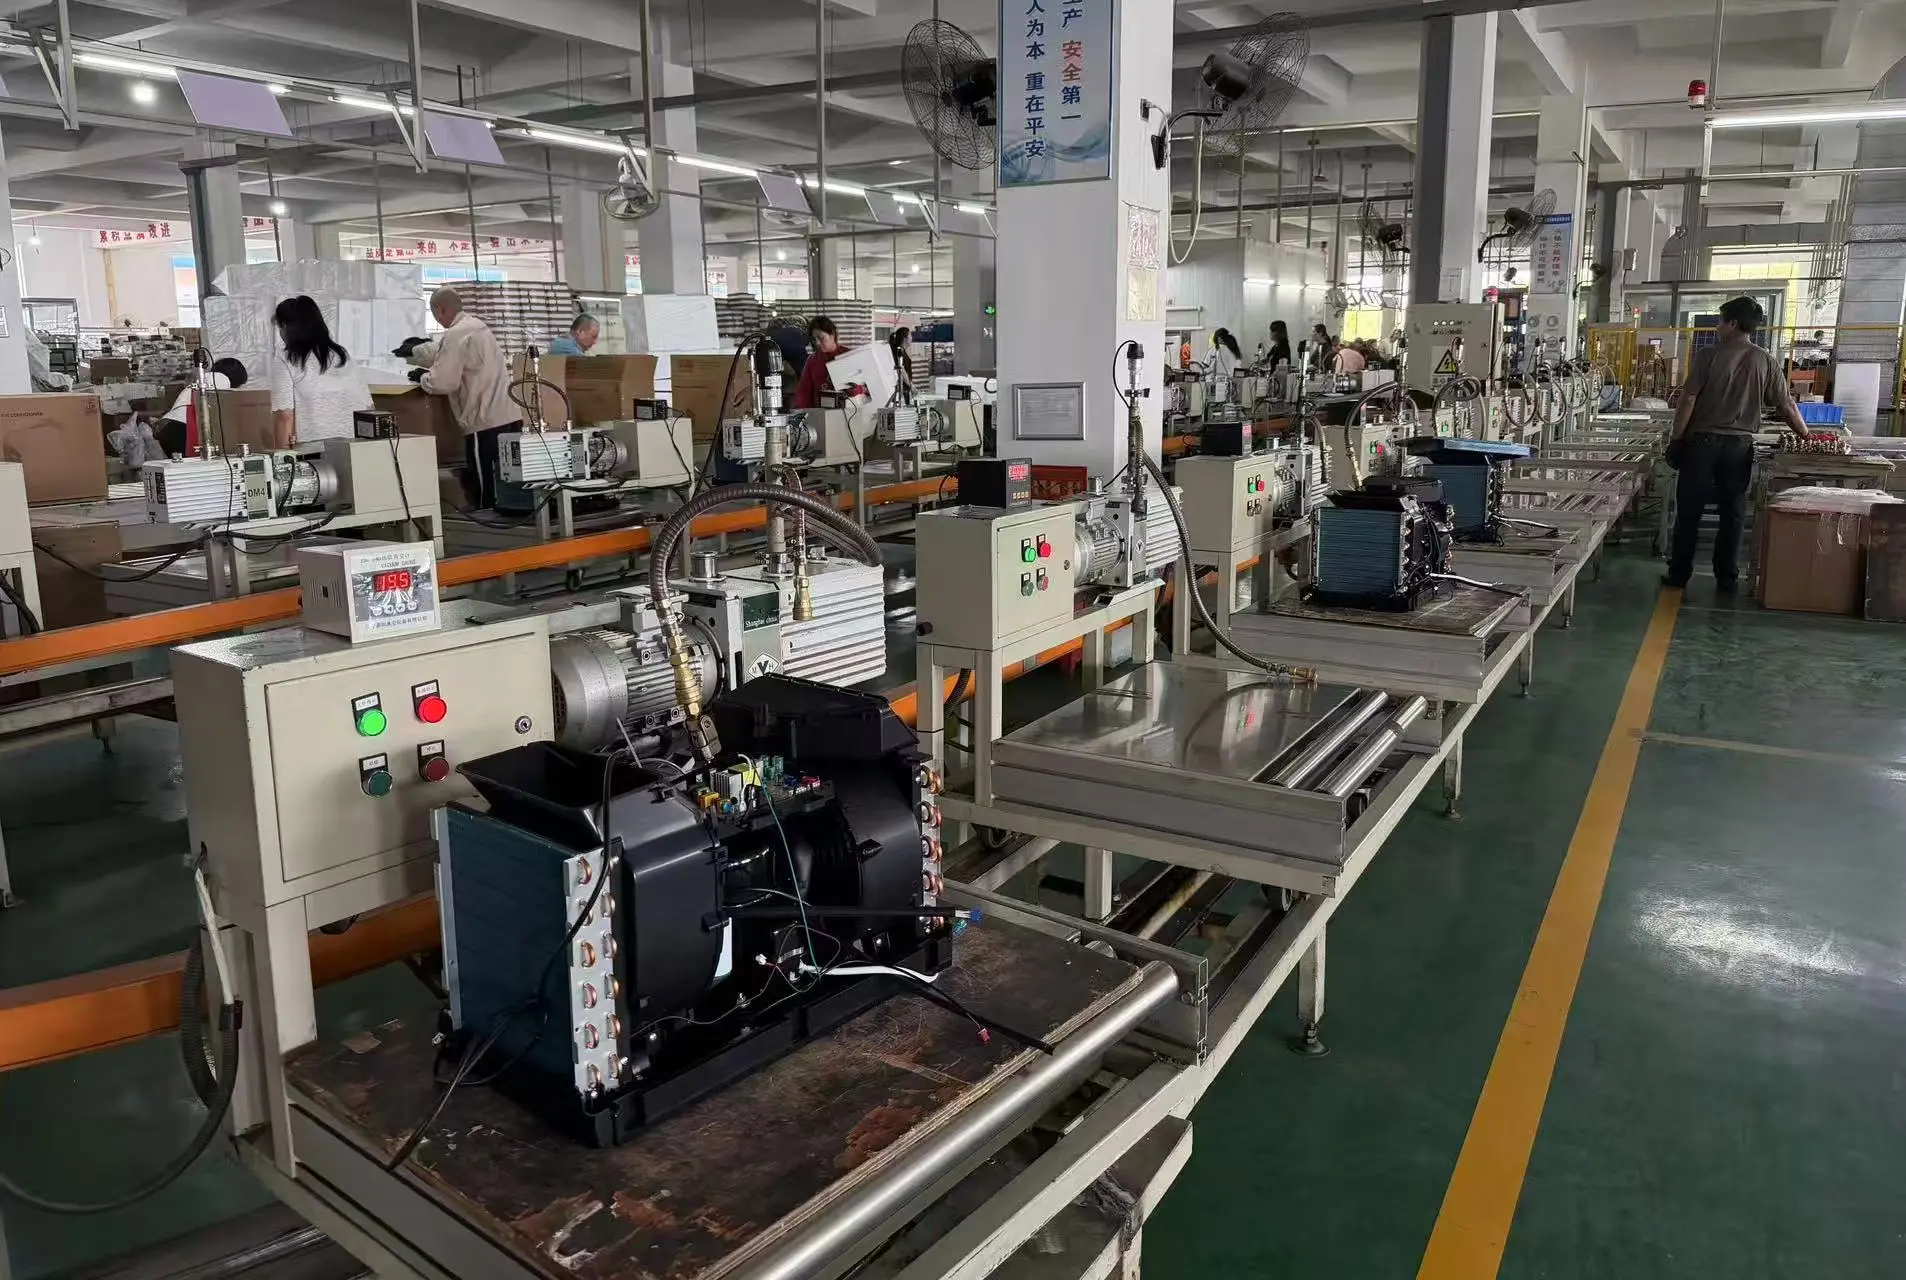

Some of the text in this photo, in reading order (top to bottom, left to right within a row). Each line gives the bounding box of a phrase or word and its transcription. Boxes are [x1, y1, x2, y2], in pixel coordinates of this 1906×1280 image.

[1025, 0, 1045, 158] 人为本 重在平安
[1061, 39, 1082, 120] 安全第一
[247, 487, 266, 498] DM4
